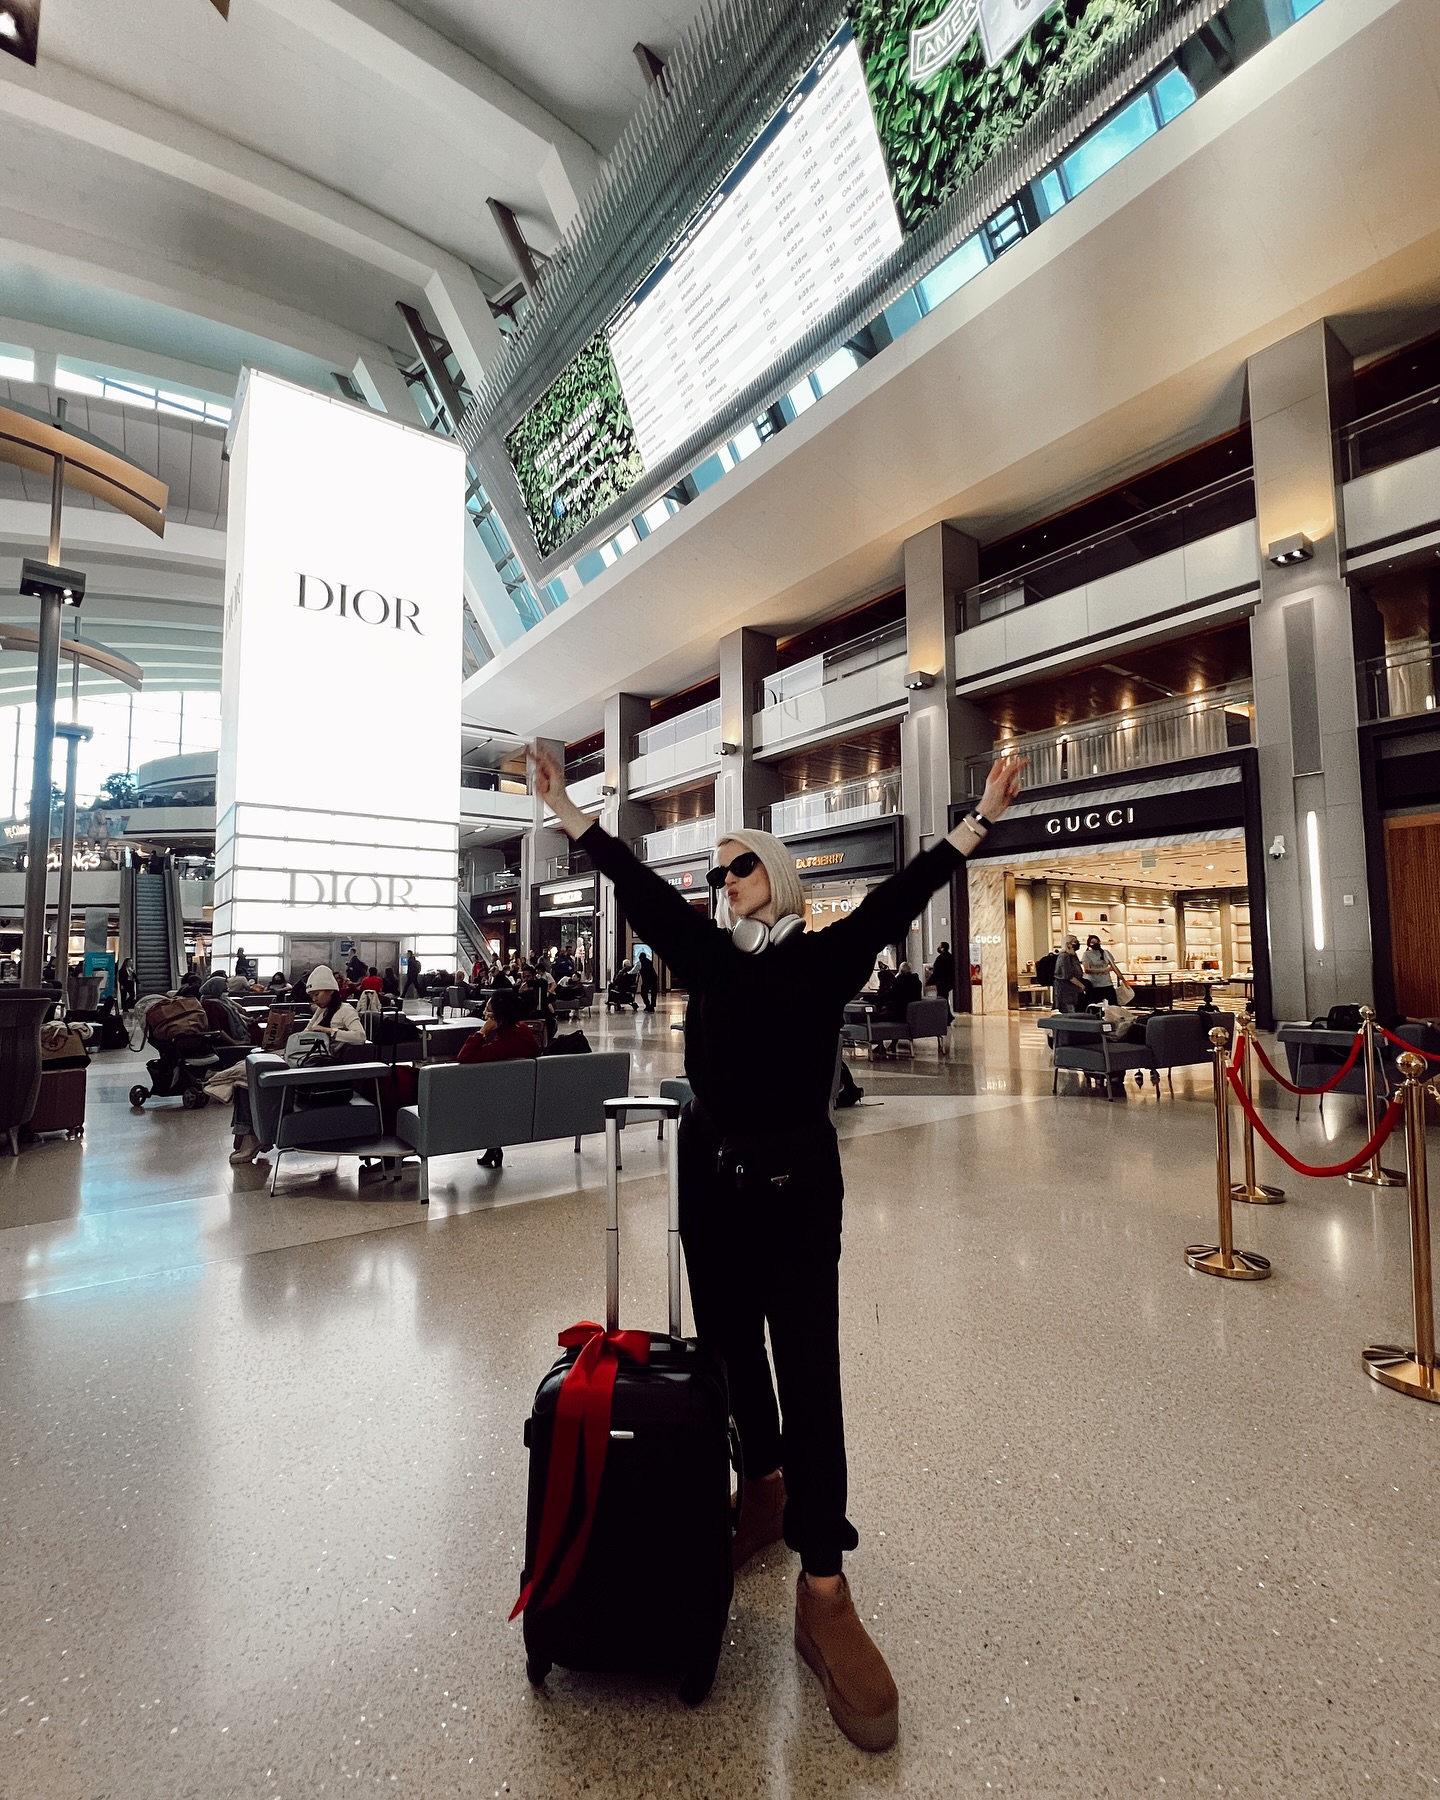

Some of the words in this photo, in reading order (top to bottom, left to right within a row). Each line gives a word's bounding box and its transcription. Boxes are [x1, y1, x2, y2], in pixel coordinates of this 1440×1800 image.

[817, 84, 827, 100] ON
[827, 67, 840, 87] TIME
[787, 93, 803, 113] Gate
[821, 101, 831, 116] ON
[830, 84, 844, 104] TIME
[825, 116, 838, 133] Now
[850, 88, 860, 103] PM
[798, 129, 809, 144] 134
[829, 134, 840, 149] ON
[839, 118, 853, 137] TIME
[833, 151, 844, 165] ON
[843, 135, 858, 154] TIME
[803, 161, 818, 179] 201A
[837, 167, 848, 182] ON
[847, 152, 862, 171] TIME
[809, 178, 821, 193] 204
[841, 184, 852, 198] ON
[851, 169, 866, 187] TIME
[736, 202, 749, 219] WAW
[814, 194, 825, 208] 133
[845, 200, 856, 214] ON
[855, 185, 870, 204] TIME
[849, 215, 863, 231] Now
[875, 190, 885, 204] PM
[740, 218, 751, 234] MUC
[818, 210, 828, 223] 141
[669, 238, 689, 262] Tuesday,
[688, 208, 712, 239] December
[822, 225, 833, 239] 130
[853, 233, 864, 246] ON
[863, 219, 878, 236] TIME
[747, 248, 758, 262] MSP
[857, 249, 868, 262] ON
[867, 235, 882, 252] TIME
[790, 257, 802, 272] 6:10
[861, 265, 872, 278] ON
[871, 251, 885, 268] TIME
[755, 277, 766, 290] MEX
[794, 272, 806, 287] 6:20
[608, 301, 636, 337] Departures
[766, 318, 777, 332] CDG
[534, 439, 561, 471] HERE'S
[561, 432, 568, 445] A
[568, 398, 601, 437] CHANGE
[549, 459, 558, 475] OF
[293, 571, 426, 637] DIOR
[1045, 807, 1134, 835] GUCCI
[284, 871, 418, 912] DIOR
[975, 935, 1001, 944] GUCCI
